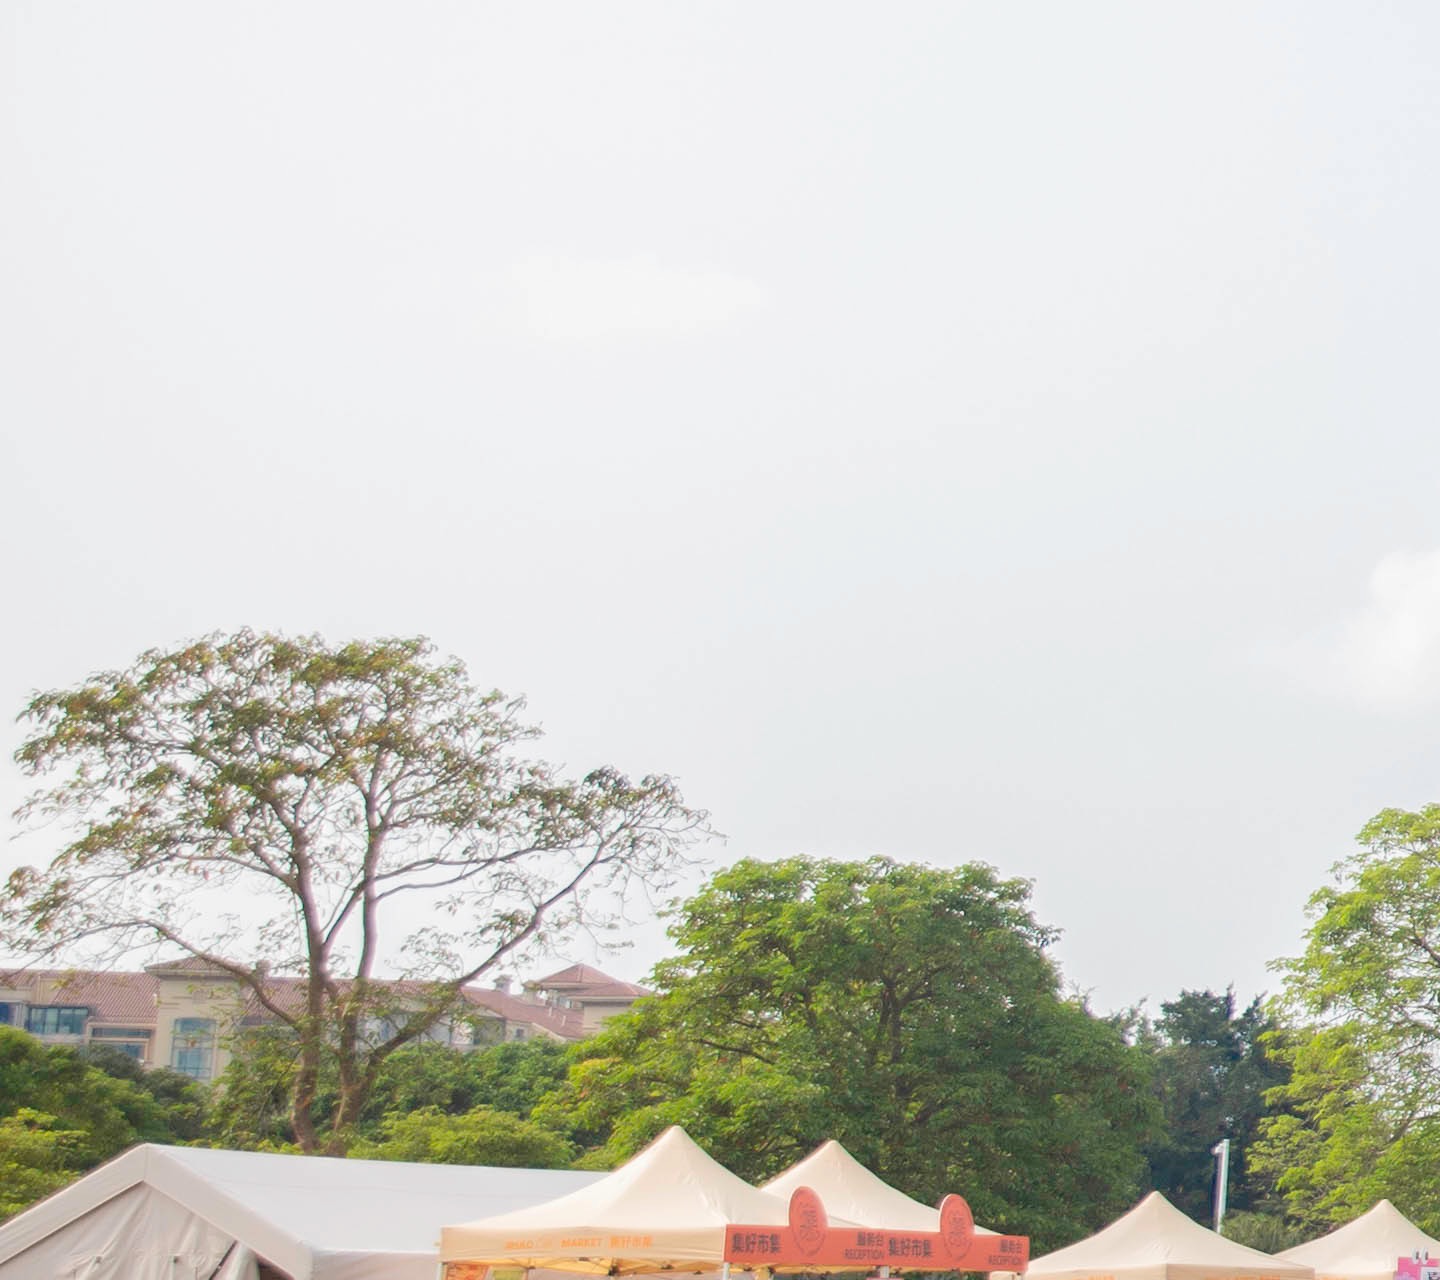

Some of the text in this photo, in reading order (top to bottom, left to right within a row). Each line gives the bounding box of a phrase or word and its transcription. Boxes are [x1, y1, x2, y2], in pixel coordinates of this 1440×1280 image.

[731, 1231, 782, 1254] 集好市集
[888, 1237, 933, 1258] 集好市集
